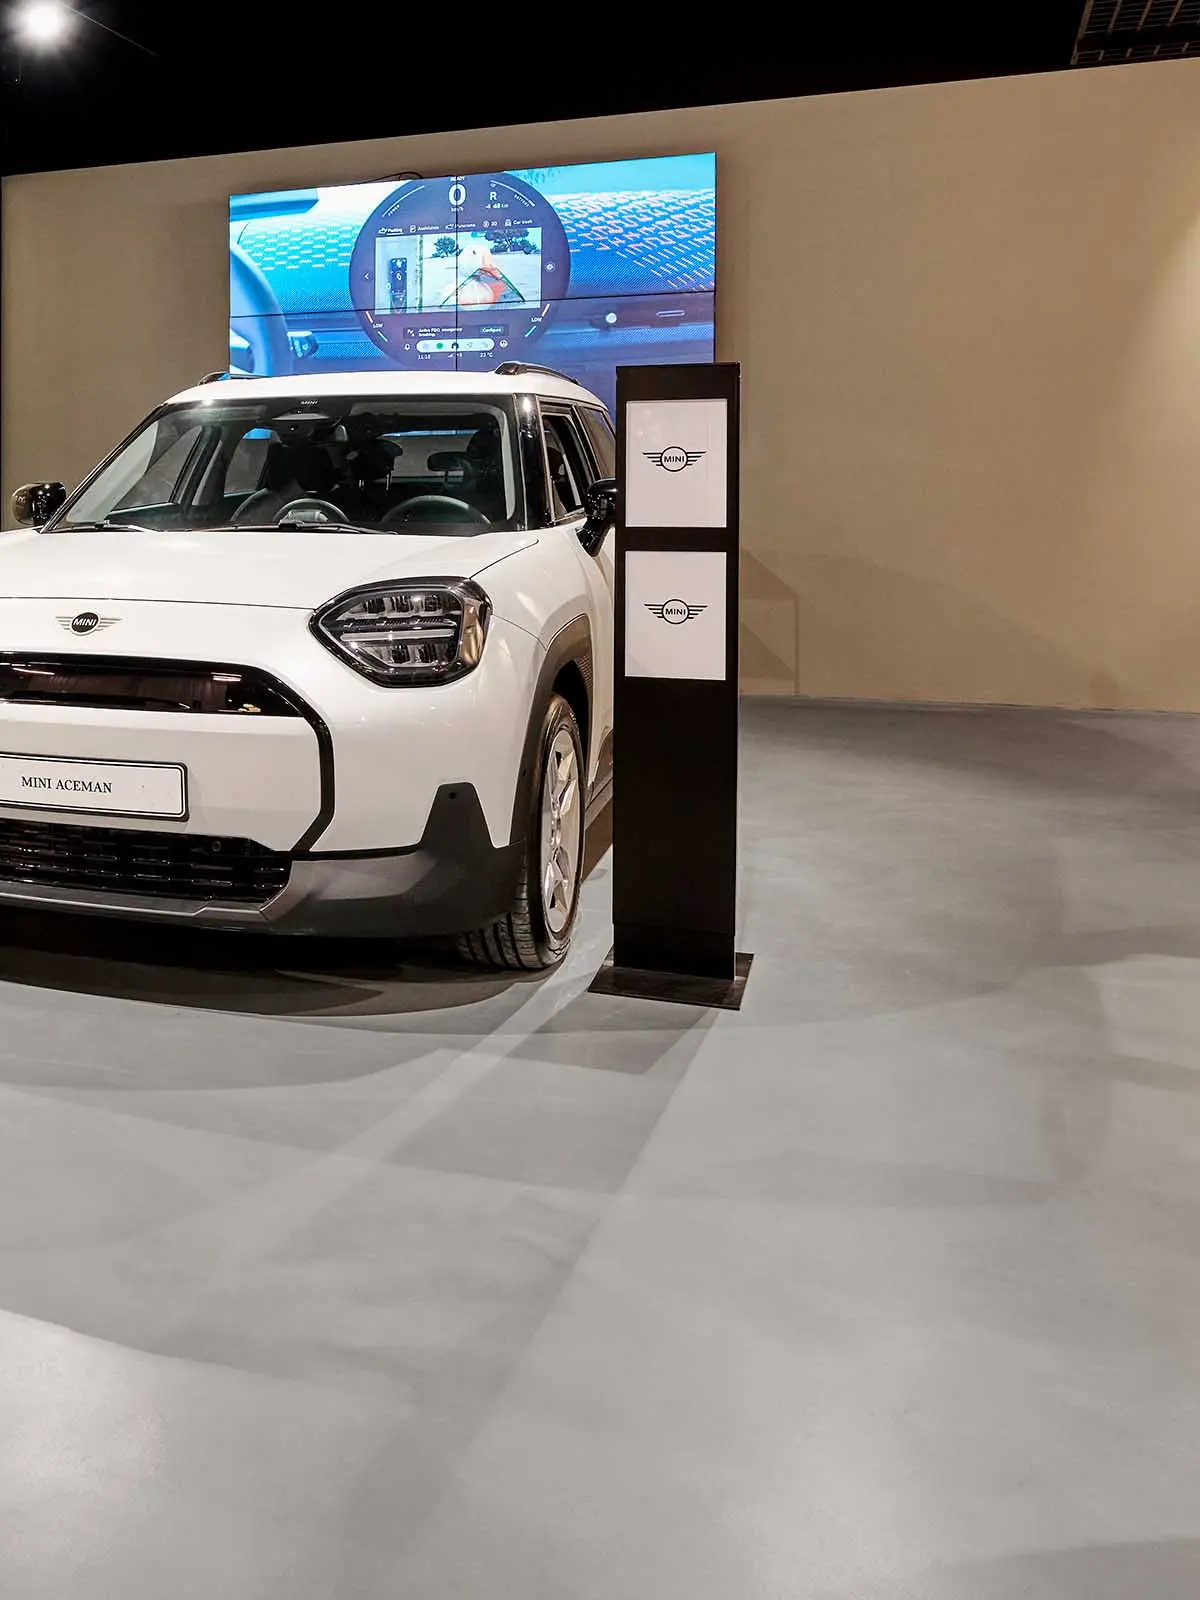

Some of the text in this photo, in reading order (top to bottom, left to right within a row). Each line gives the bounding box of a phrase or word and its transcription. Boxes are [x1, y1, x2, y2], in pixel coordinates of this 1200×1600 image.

[448, 184, 466, 206] 0
[490, 192, 498, 201] R
[663, 455, 685, 463] MINI
[665, 608, 686, 616] MINI
[73, 618, 97, 626] MINI
[21, 776, 112, 793] MINI ACEMAN
